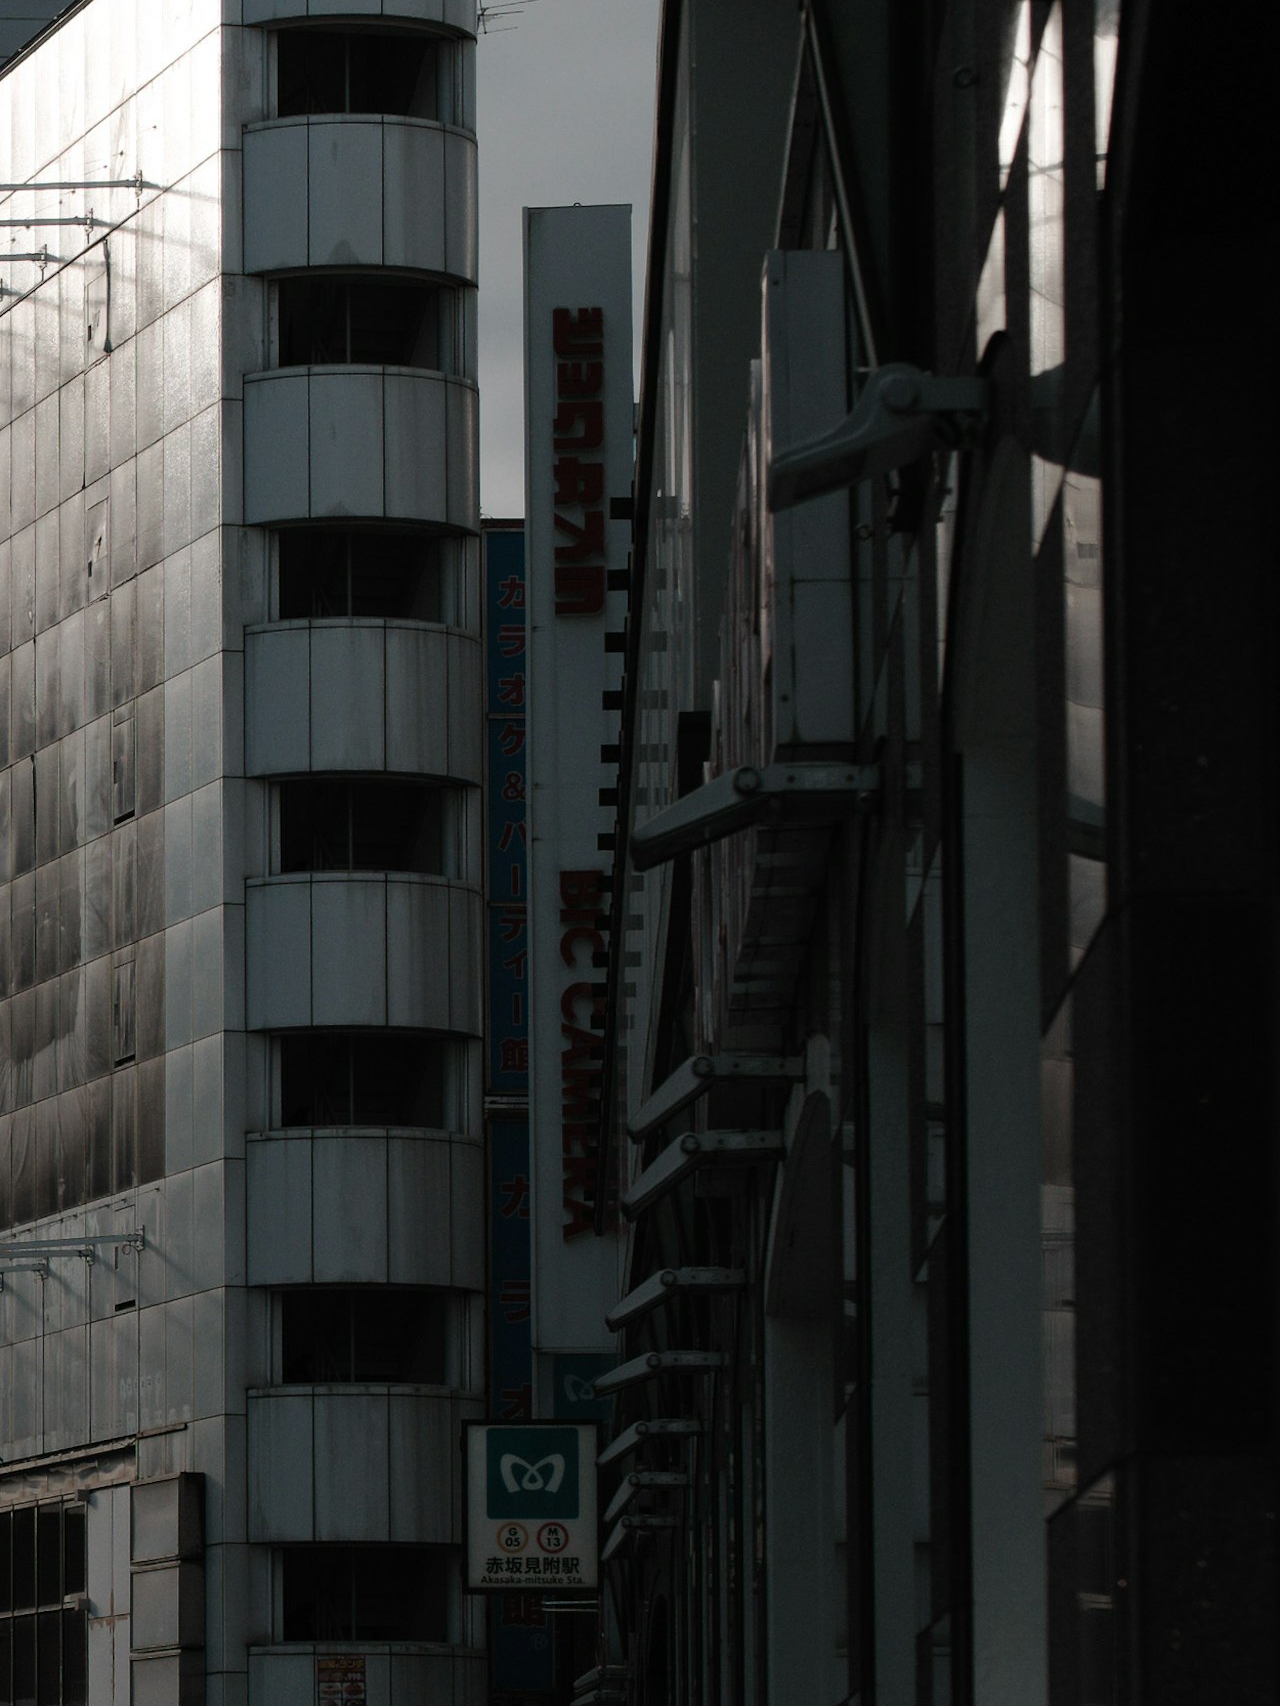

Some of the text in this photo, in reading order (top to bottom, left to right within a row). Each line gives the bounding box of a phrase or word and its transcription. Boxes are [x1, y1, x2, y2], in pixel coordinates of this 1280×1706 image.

[553, 307, 604, 616] ビックカメラ
[559, 870, 606, 1241] BIC CAMERA
[509, 1527, 558, 1537] G M
[506, 1537, 561, 1547] 05 13
[486, 1557, 580, 1574] 赤坂見附駅
[481, 1575, 586, 1586] Akasaka-mitsuke Sta.
